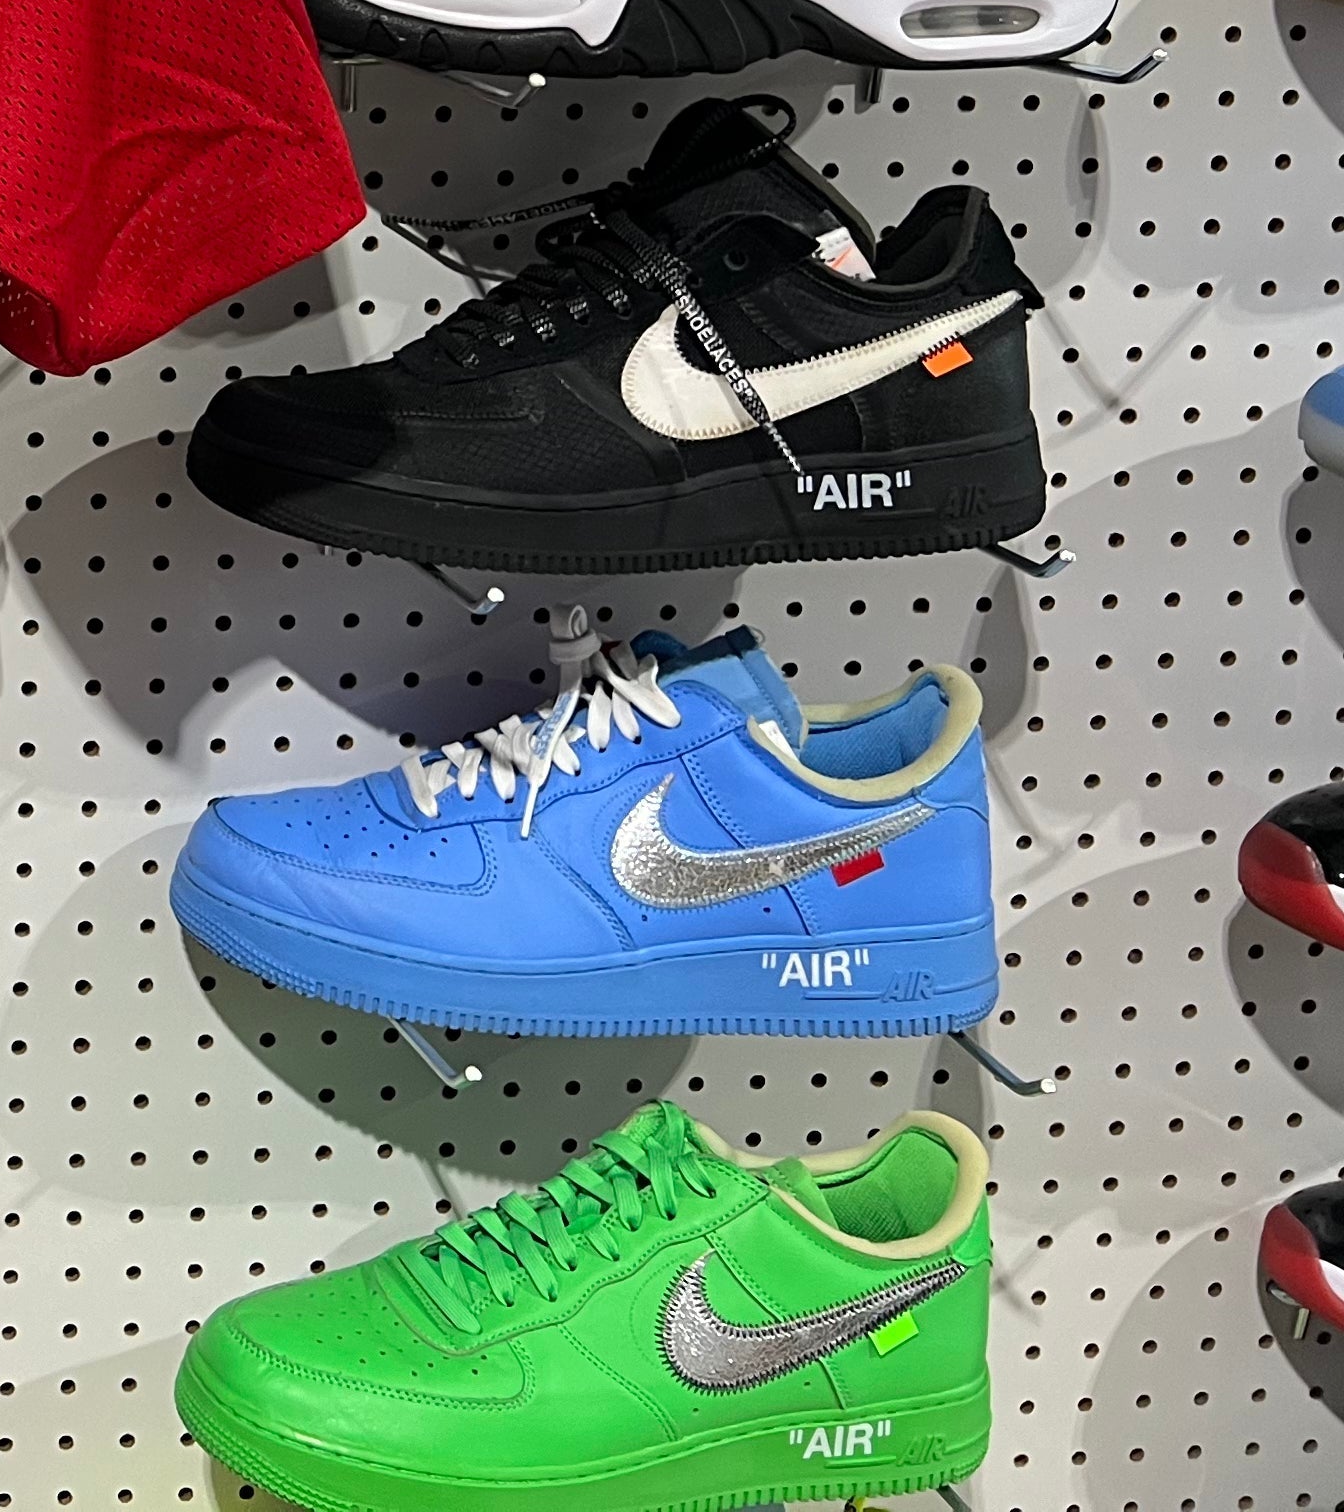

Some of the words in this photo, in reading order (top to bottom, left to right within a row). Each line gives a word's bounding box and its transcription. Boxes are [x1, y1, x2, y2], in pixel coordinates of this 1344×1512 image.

[797, 469, 911, 510] "AIR"
[762, 948, 870, 988] "AIR"
[789, 1419, 891, 1460] "AIR"
